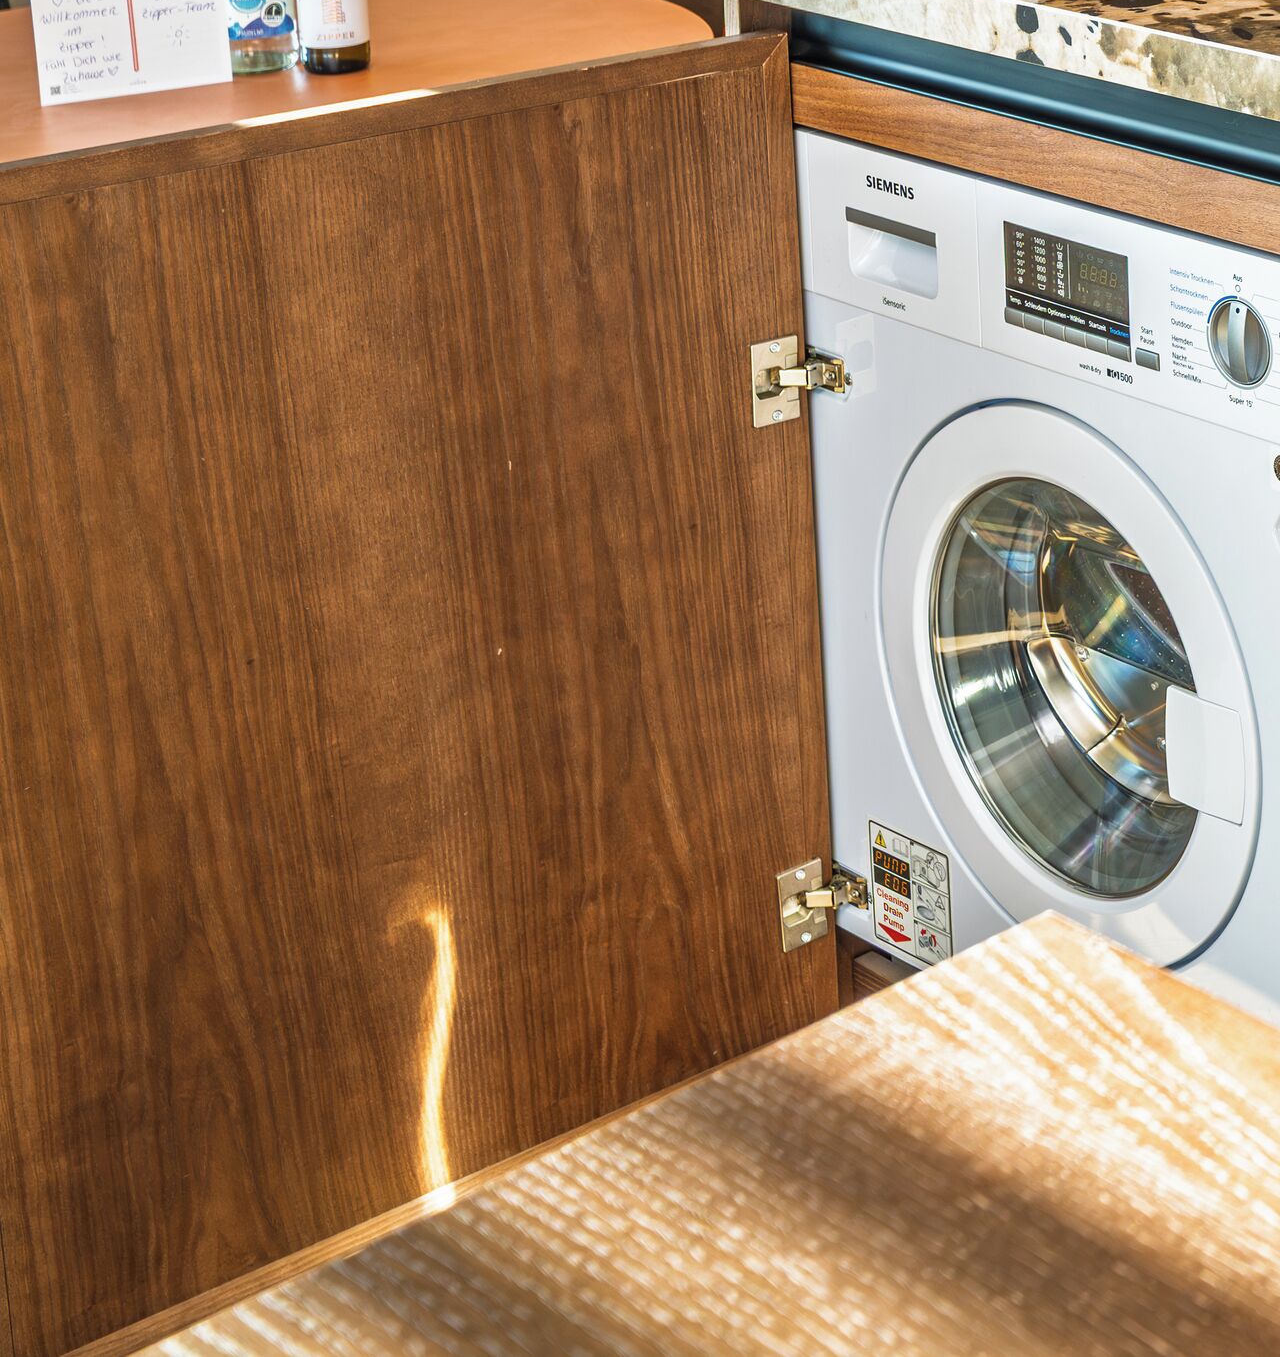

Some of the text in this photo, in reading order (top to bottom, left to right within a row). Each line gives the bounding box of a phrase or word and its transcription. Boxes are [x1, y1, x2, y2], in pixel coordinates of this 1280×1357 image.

[865, 174, 916, 201] SIEMENS
[1033, 236, 1046, 247] 1400
[1033, 246, 1046, 256] 1200
[1034, 254, 1047, 265] 1000
[1036, 264, 1047, 274] 800
[1190, 273, 1215, 286] Trocknen
[1232, 273, 1243, 283] Aus
[1170, 317, 1193, 330] Outdoor
[1140, 326, 1154, 336] Start
[1140, 335, 1155, 347] Pause
[1171, 334, 1194, 347] Hemden
[1172, 351, 1188, 363] Nacht
[1228, 394, 1245, 407] Super
[876, 887, 910, 913] Cleaning
[883, 902, 904, 920] Drain
[883, 913, 905, 933] Pump
